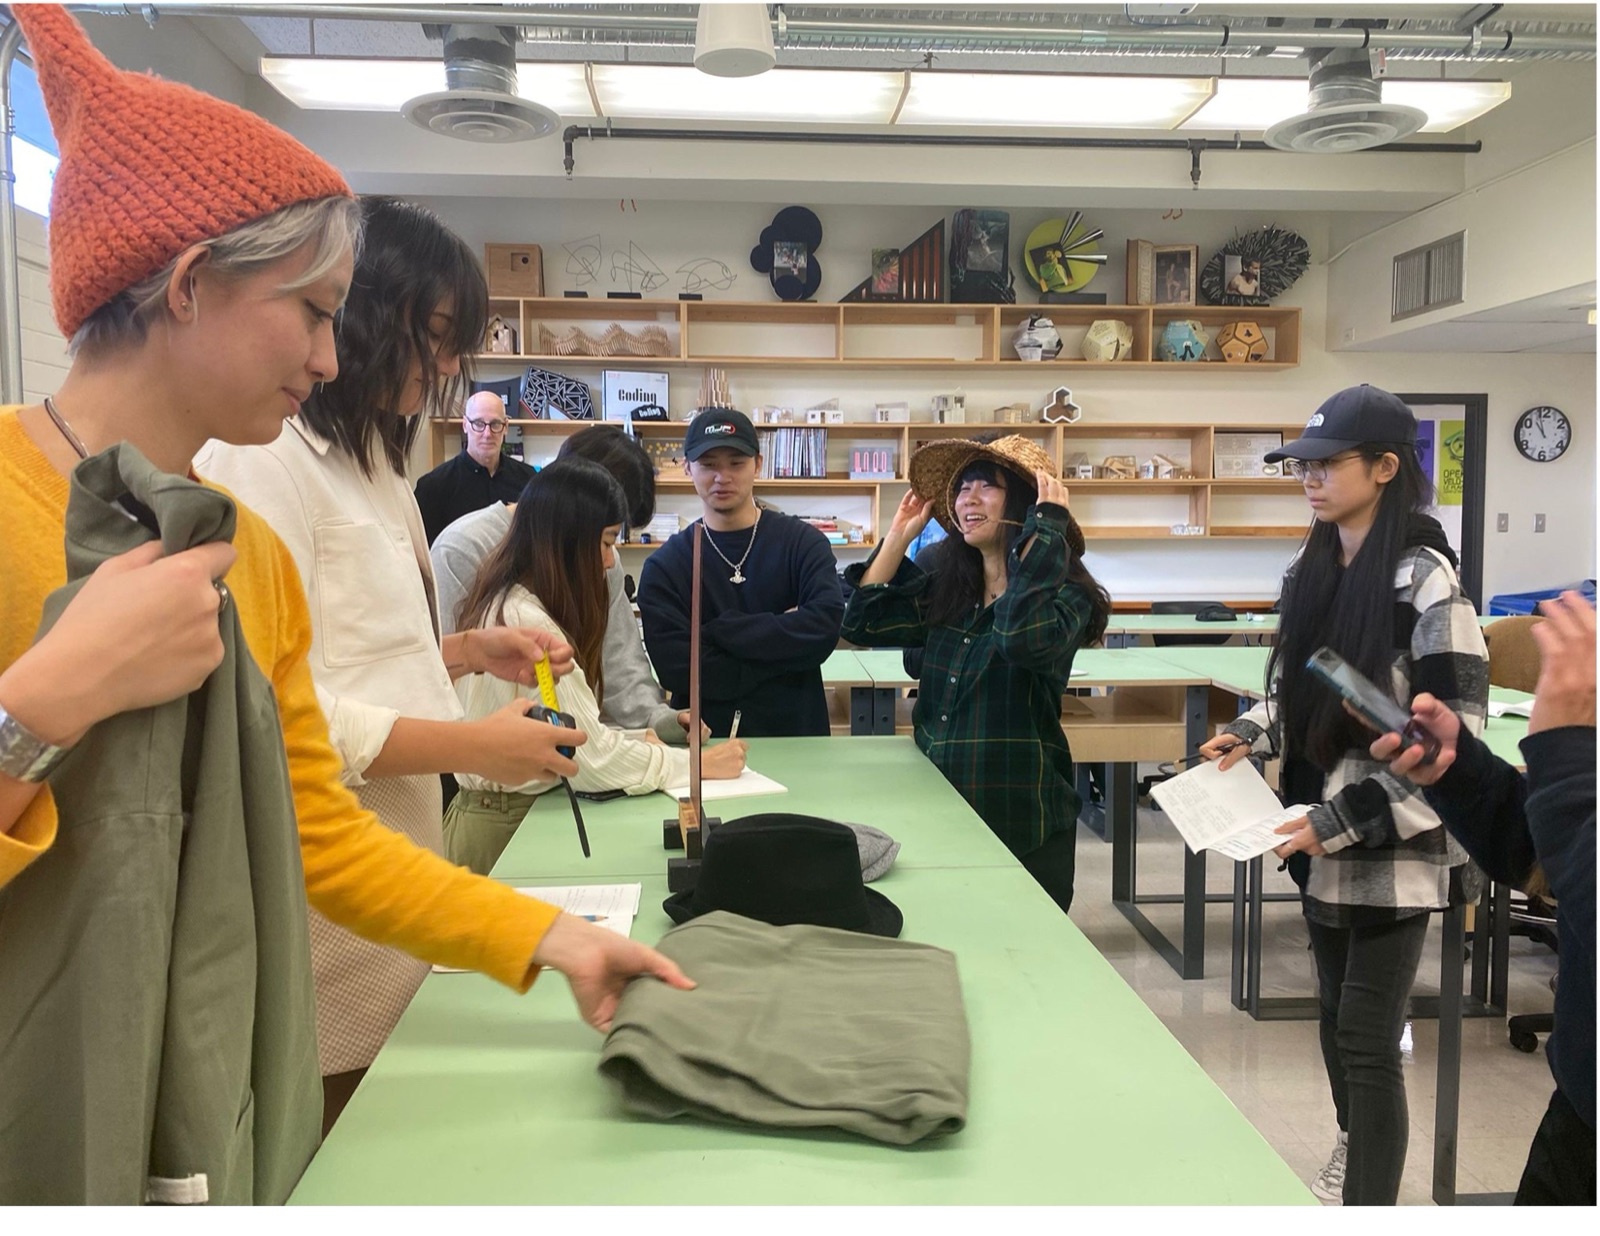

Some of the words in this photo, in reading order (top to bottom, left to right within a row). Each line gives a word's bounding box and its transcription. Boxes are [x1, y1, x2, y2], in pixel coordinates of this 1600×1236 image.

[618, 388, 656, 406] Coding
[1536, 408, 1551, 419] 12
[1556, 418, 1565, 429] 2
[1555, 440, 1565, 451] 4
[1537, 450, 1546, 461] 6
